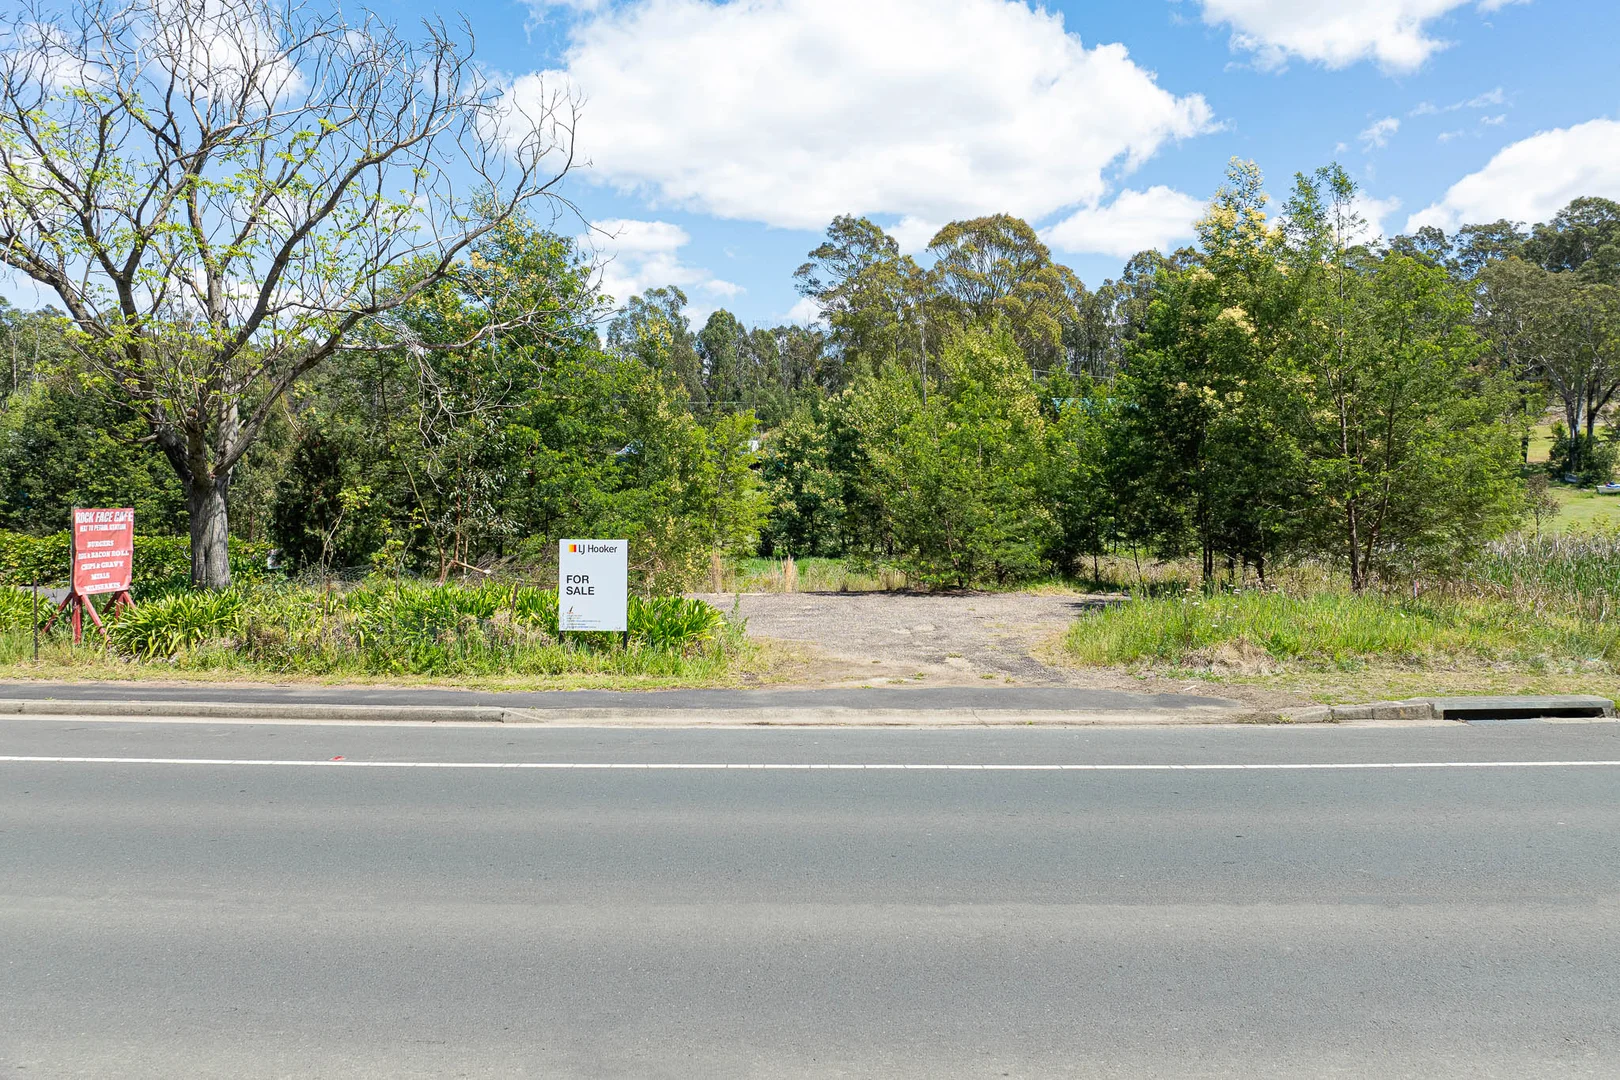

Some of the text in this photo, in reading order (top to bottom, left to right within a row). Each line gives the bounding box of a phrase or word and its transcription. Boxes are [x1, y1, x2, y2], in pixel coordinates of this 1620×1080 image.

[76, 510, 133, 523] ROCK FACE CAFE
[87, 540, 114, 548] BURGERS
[578, 544, 617, 555] LJ Hooker
[91, 551, 110, 559] BACON
[566, 575, 590, 584] FOR
[566, 586, 595, 596] SALE
